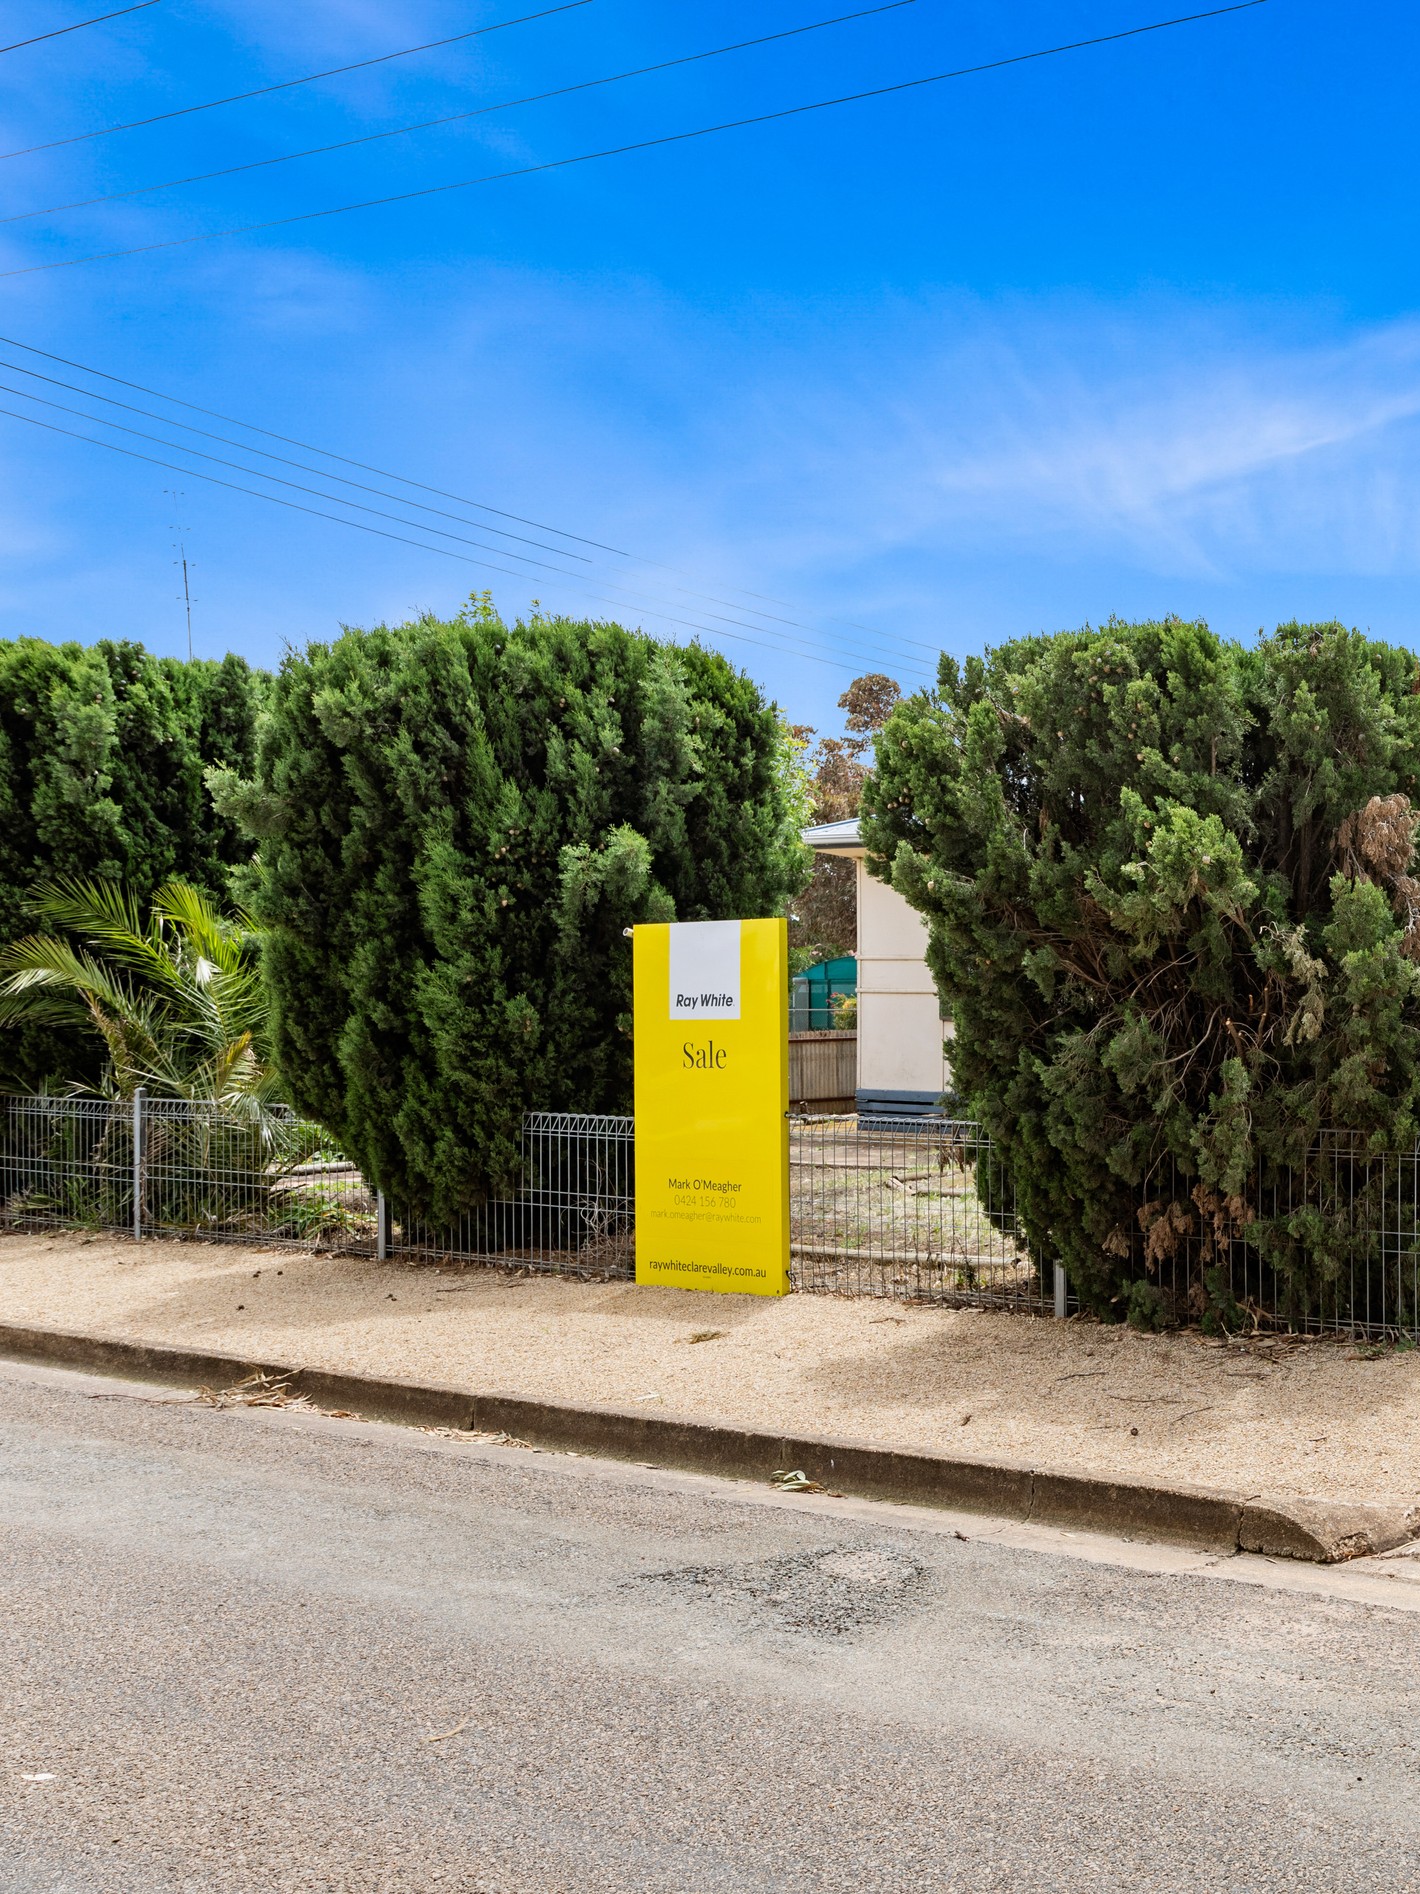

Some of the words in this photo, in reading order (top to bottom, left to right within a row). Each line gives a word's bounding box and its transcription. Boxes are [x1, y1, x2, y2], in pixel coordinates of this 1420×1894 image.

[676, 994, 698, 1009] Ray
[700, 993, 733, 1007] White
[682, 1040, 727, 1069] Sale
[668, 1178, 691, 1190] Mark
[693, 1179, 742, 1194] O'Meagher
[674, 1194, 697, 1207] 0424
[700, 1196, 717, 1208] 156
[719, 1197, 737, 1209] 780
[650, 1209, 762, 1224] mark.omeagher@raywhite.com
[649, 1260, 767, 1278] raywhiteclarevalley.com.au
